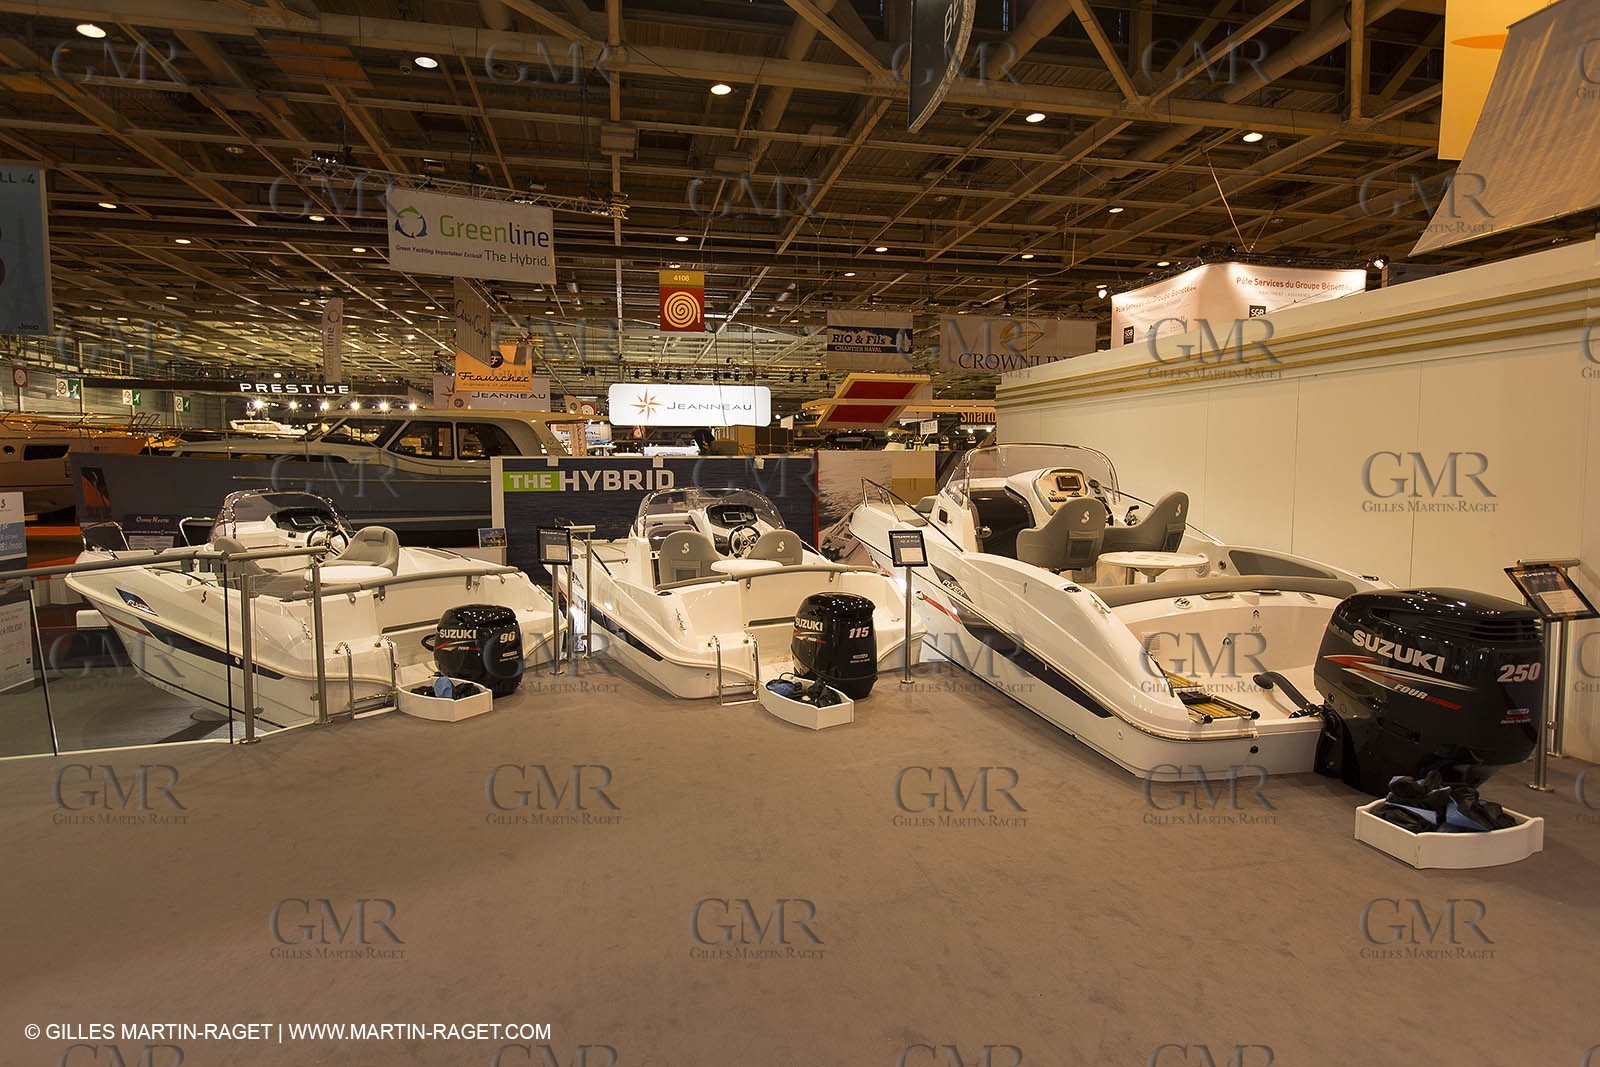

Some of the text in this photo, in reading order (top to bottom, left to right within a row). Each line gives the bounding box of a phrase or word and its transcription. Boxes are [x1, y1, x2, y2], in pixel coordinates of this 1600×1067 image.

[439, 215, 549, 248] Greenline
[484, 250, 550, 268] The Hybrid.
[1254, 278, 1284, 288] Services
[1285, 280, 1294, 289] du
[1295, 280, 1320, 291] Groupe
[832, 334, 886, 344] RIO & Fils
[240, 383, 349, 394] PRESTIGE
[667, 400, 752, 412] JEANNEAU
[510, 470, 674, 492] THE HYBRID
[795, 618, 824, 632] SUZUKI
[440, 629, 477, 638] SUZUKI
[500, 632, 516, 644] 90
[848, 626, 870, 640] 115
[1352, 629, 1446, 674] SUZUKI
[1497, 662, 1541, 682] 250
[1394, 684, 1428, 700] FOUR
